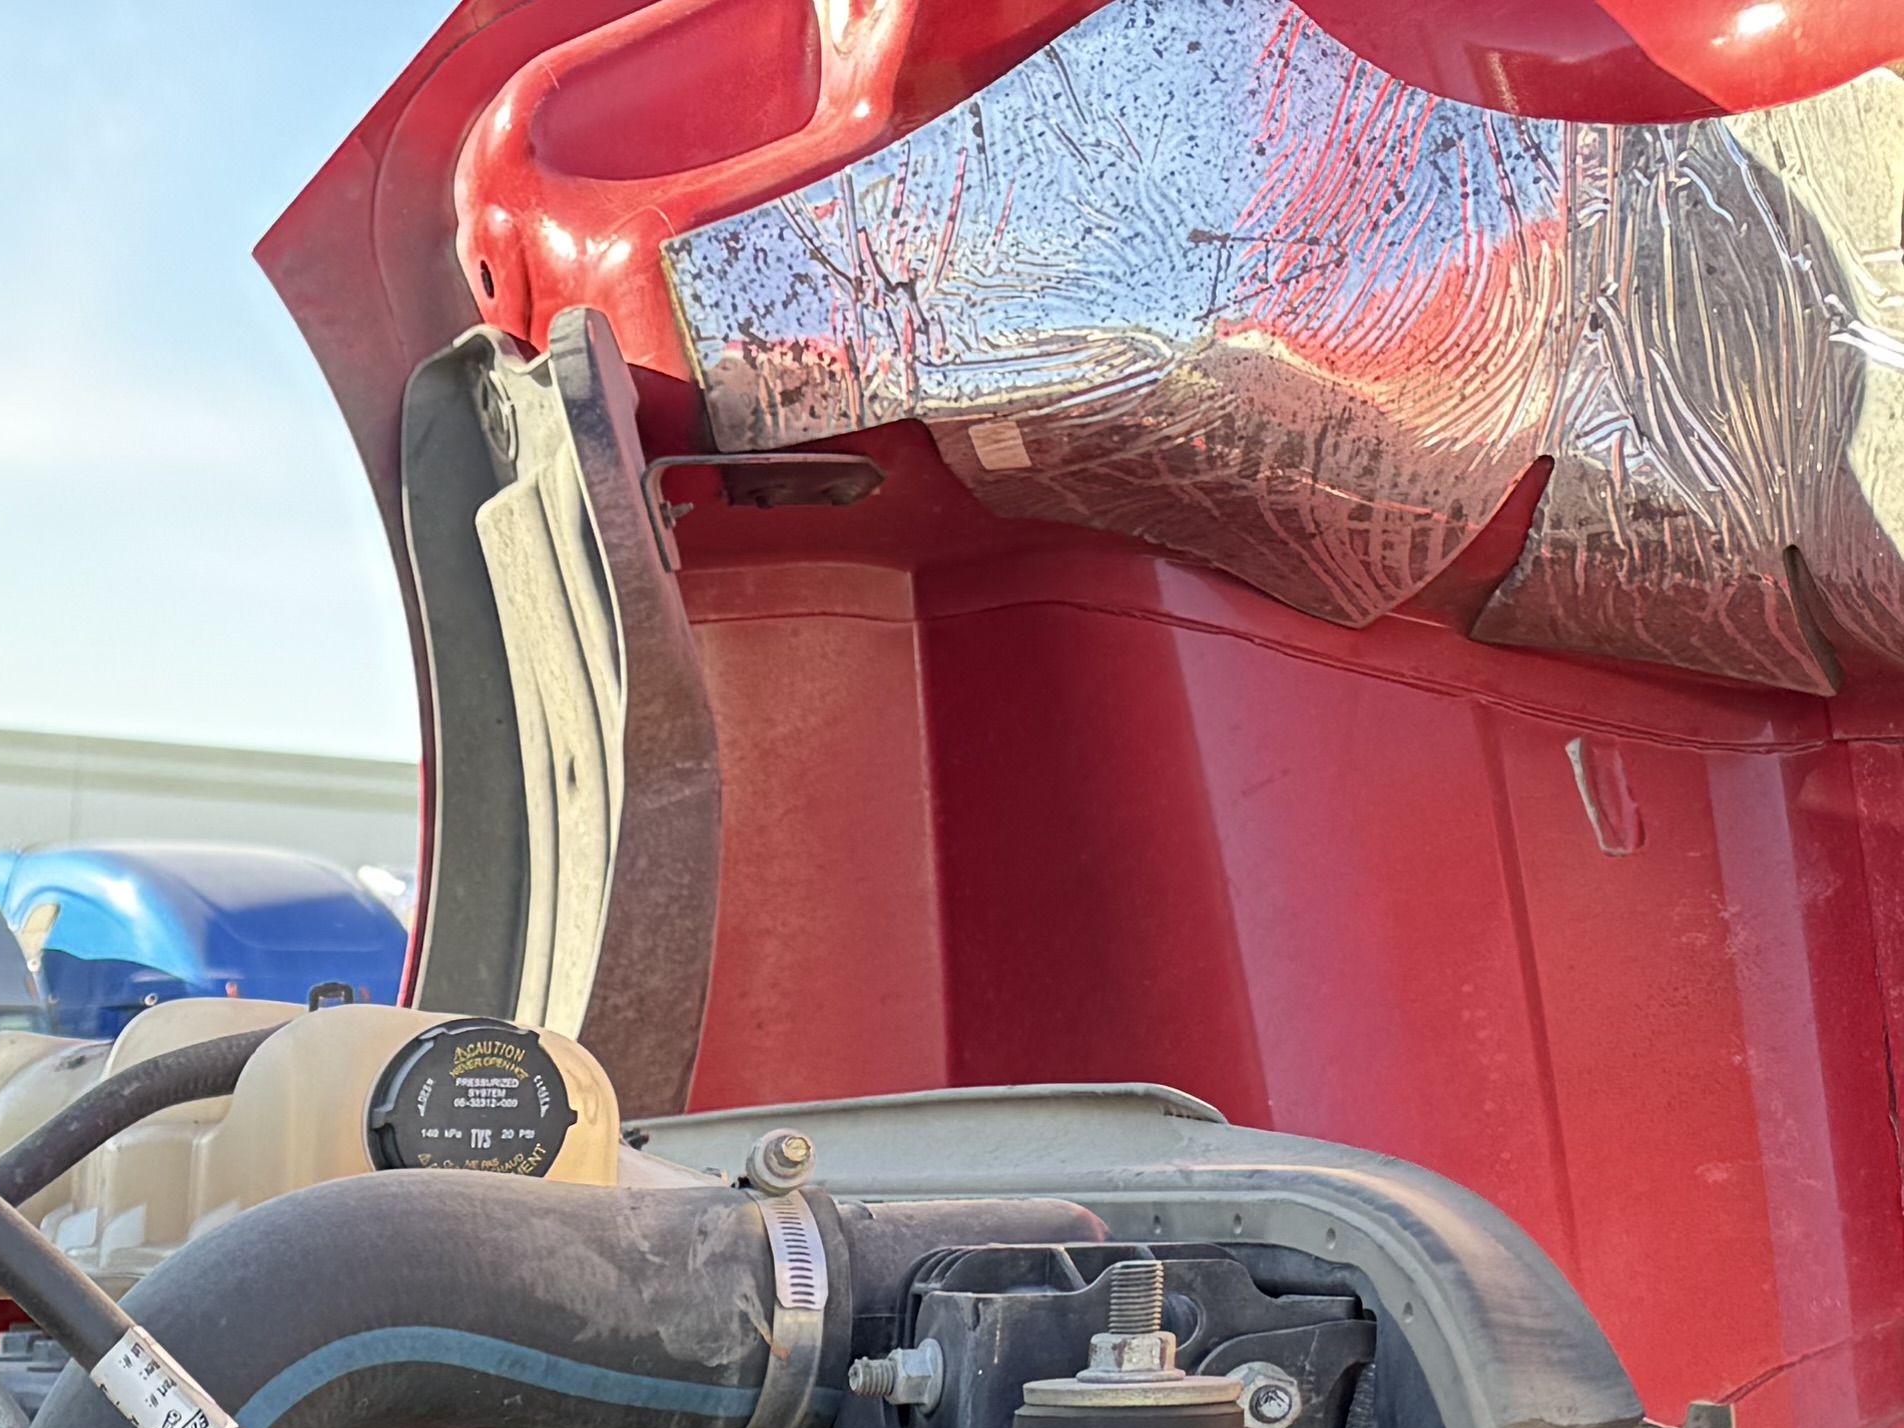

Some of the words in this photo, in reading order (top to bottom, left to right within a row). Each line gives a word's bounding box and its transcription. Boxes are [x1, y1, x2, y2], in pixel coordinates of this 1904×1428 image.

[467, 1041, 526, 1061] CAUTION
[455, 1078, 519, 1088] PRESSURIZED
[468, 1088, 506, 1097] SYSTEM
[471, 1128, 492, 1149] TVS
[501, 1129, 514, 1139] 20
